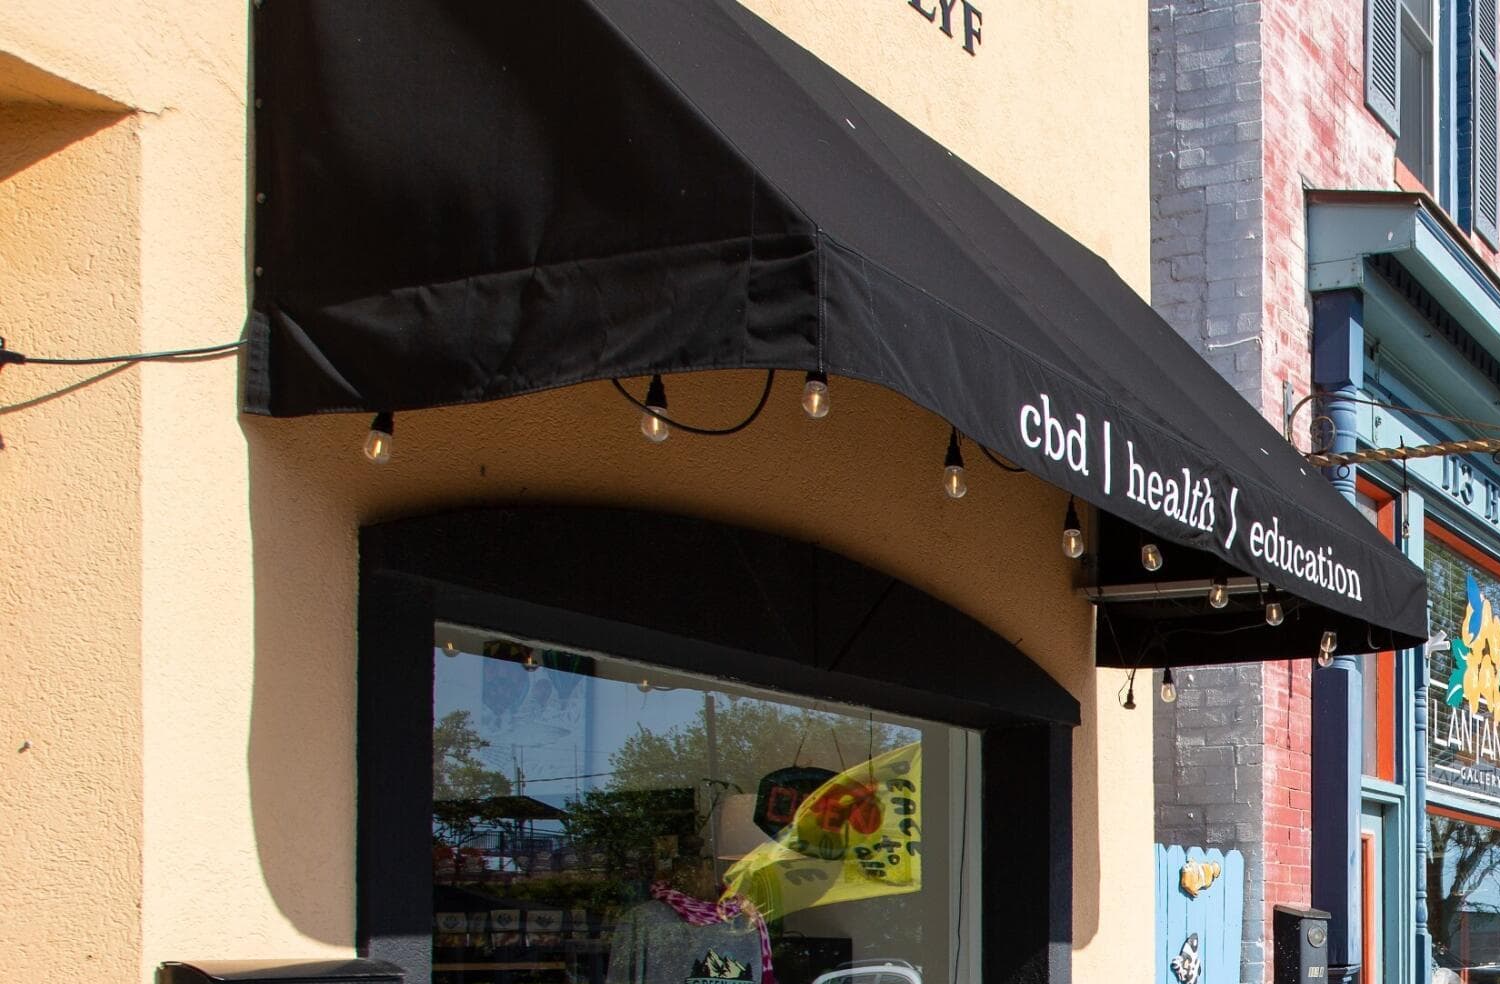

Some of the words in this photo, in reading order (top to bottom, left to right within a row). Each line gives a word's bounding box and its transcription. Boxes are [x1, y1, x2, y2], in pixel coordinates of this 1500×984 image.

[1020, 394, 1089, 476] cbd
[1127, 441, 1215, 532] health
[1250, 517, 1362, 601] education
[1442, 455, 1474, 505] 113
